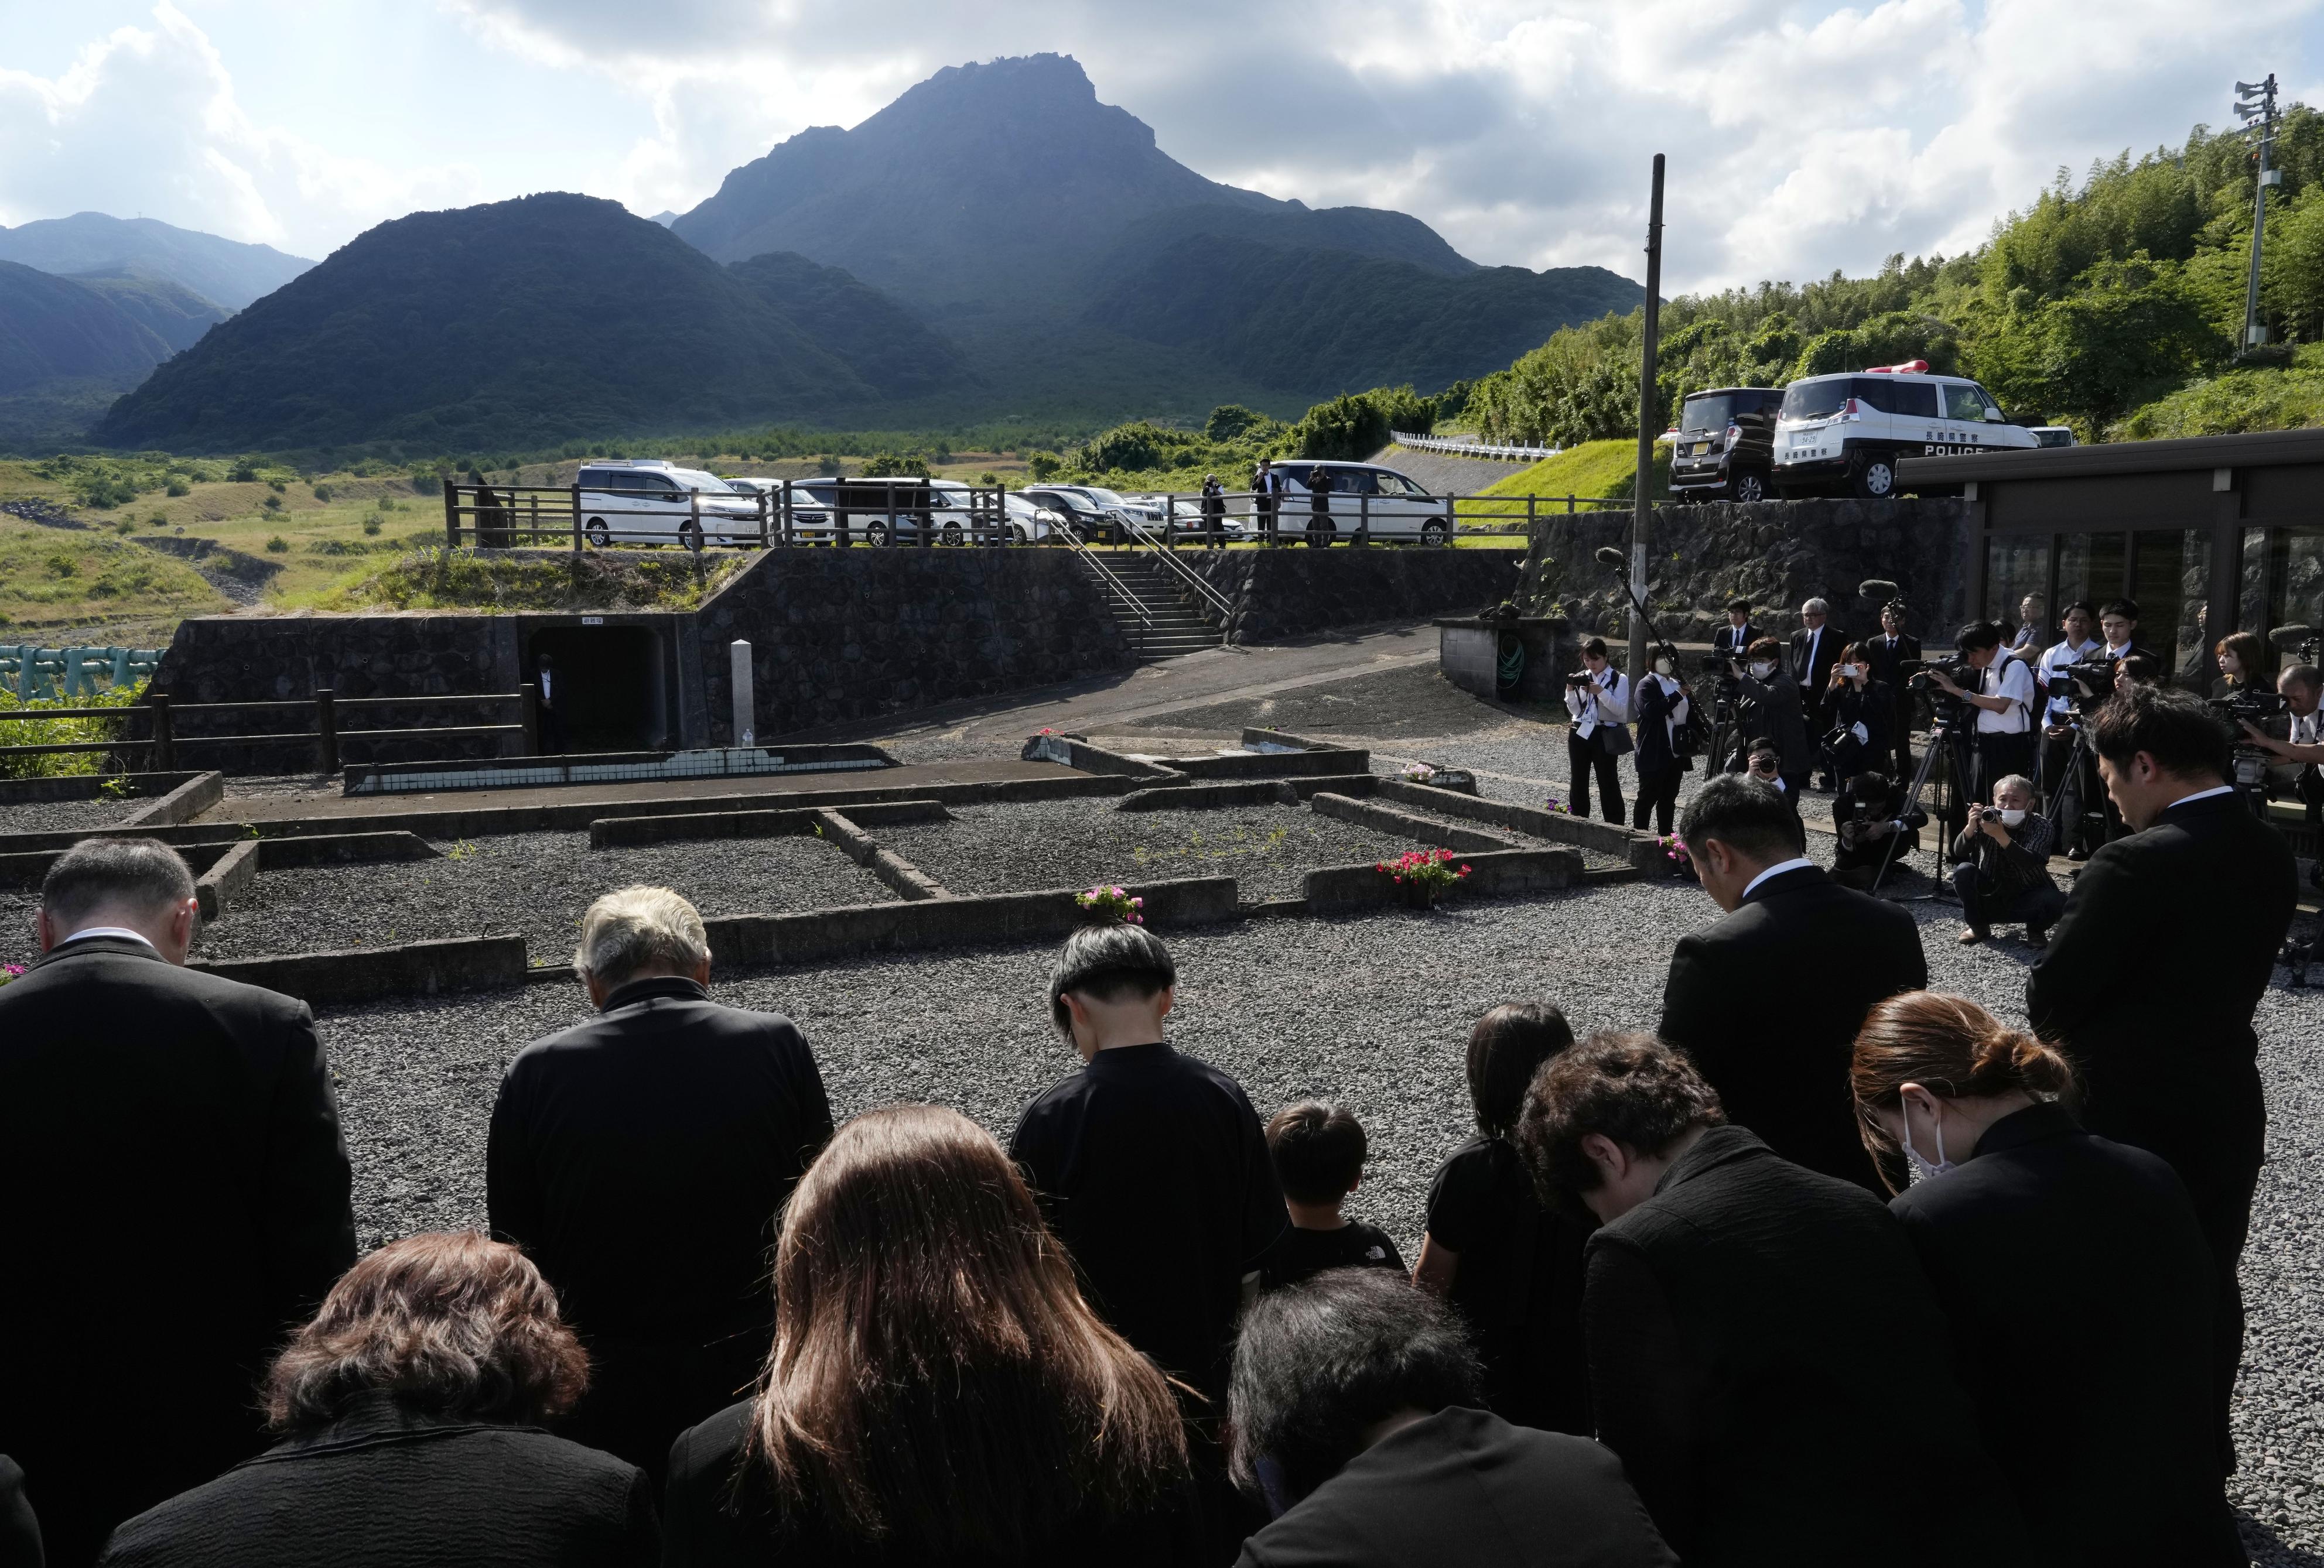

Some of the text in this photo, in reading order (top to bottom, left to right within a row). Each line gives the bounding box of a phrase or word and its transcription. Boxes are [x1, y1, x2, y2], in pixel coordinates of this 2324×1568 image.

[1926, 431, 1978, 443] 長崎県警察
[1785, 448, 1827, 460] 長崎県警察
[1925, 445, 1984, 456] POLICE
